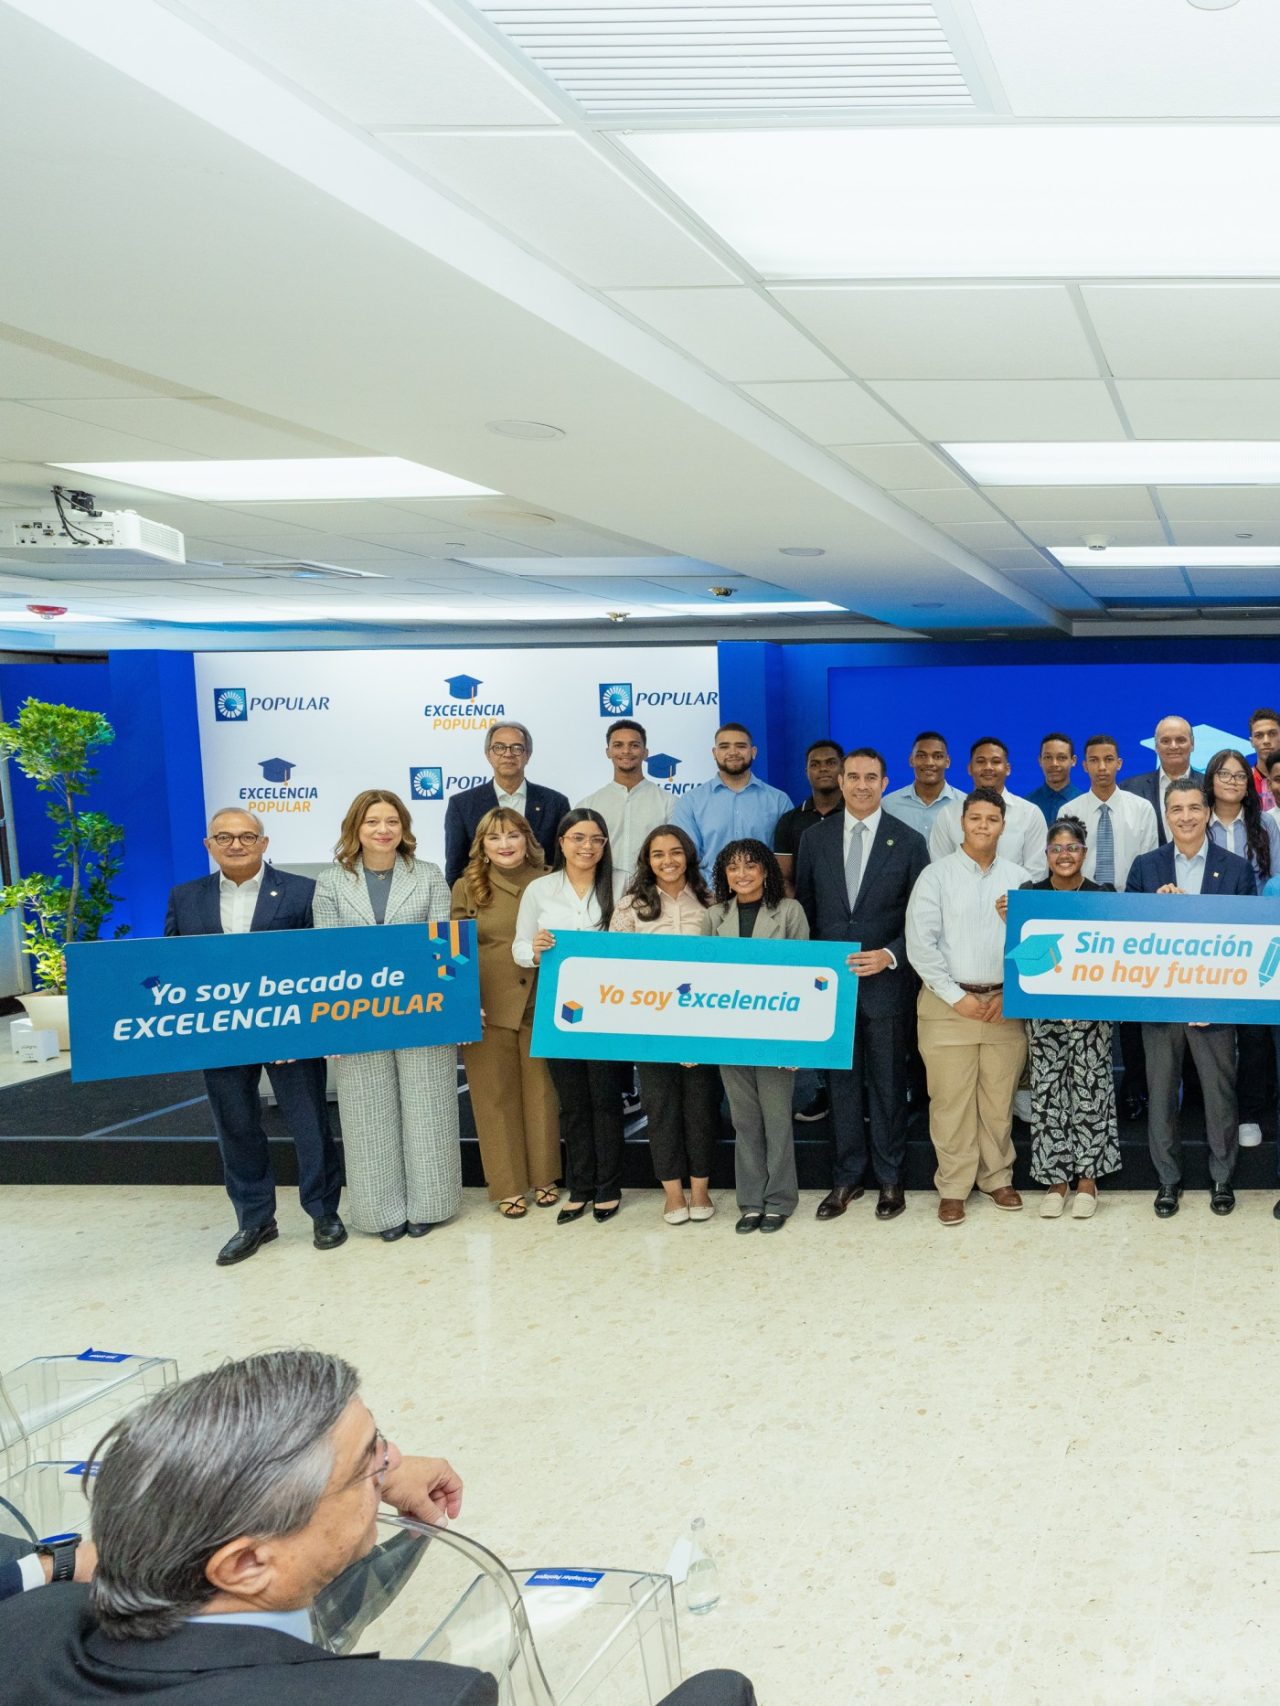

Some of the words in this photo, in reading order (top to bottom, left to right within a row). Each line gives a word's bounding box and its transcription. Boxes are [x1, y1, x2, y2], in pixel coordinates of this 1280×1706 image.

[249, 696, 331, 711] POPULAR
[635, 691, 719, 706] POPULAR
[424, 704, 506, 717] EXCELENCIA
[239, 786, 319, 800] EXCELENCIA
[249, 801, 312, 813] POPULAR
[1075, 931, 1115, 954] Sin
[1123, 933, 1254, 958] educación
[1071, 963, 1104, 983] no
[1111, 960, 1160, 989] hay
[1163, 961, 1249, 989] futuro
[151, 983, 187, 1007] Yo
[195, 980, 251, 1005] soy
[258, 969, 367, 998] becado
[370, 966, 405, 988] de
[598, 984, 625, 1005] Yo
[629, 989, 673, 1012] soy
[677, 989, 801, 1013] excelencia
[112, 1003, 301, 1042] EXCELENCIA
[310, 991, 444, 1024] POPULAR
